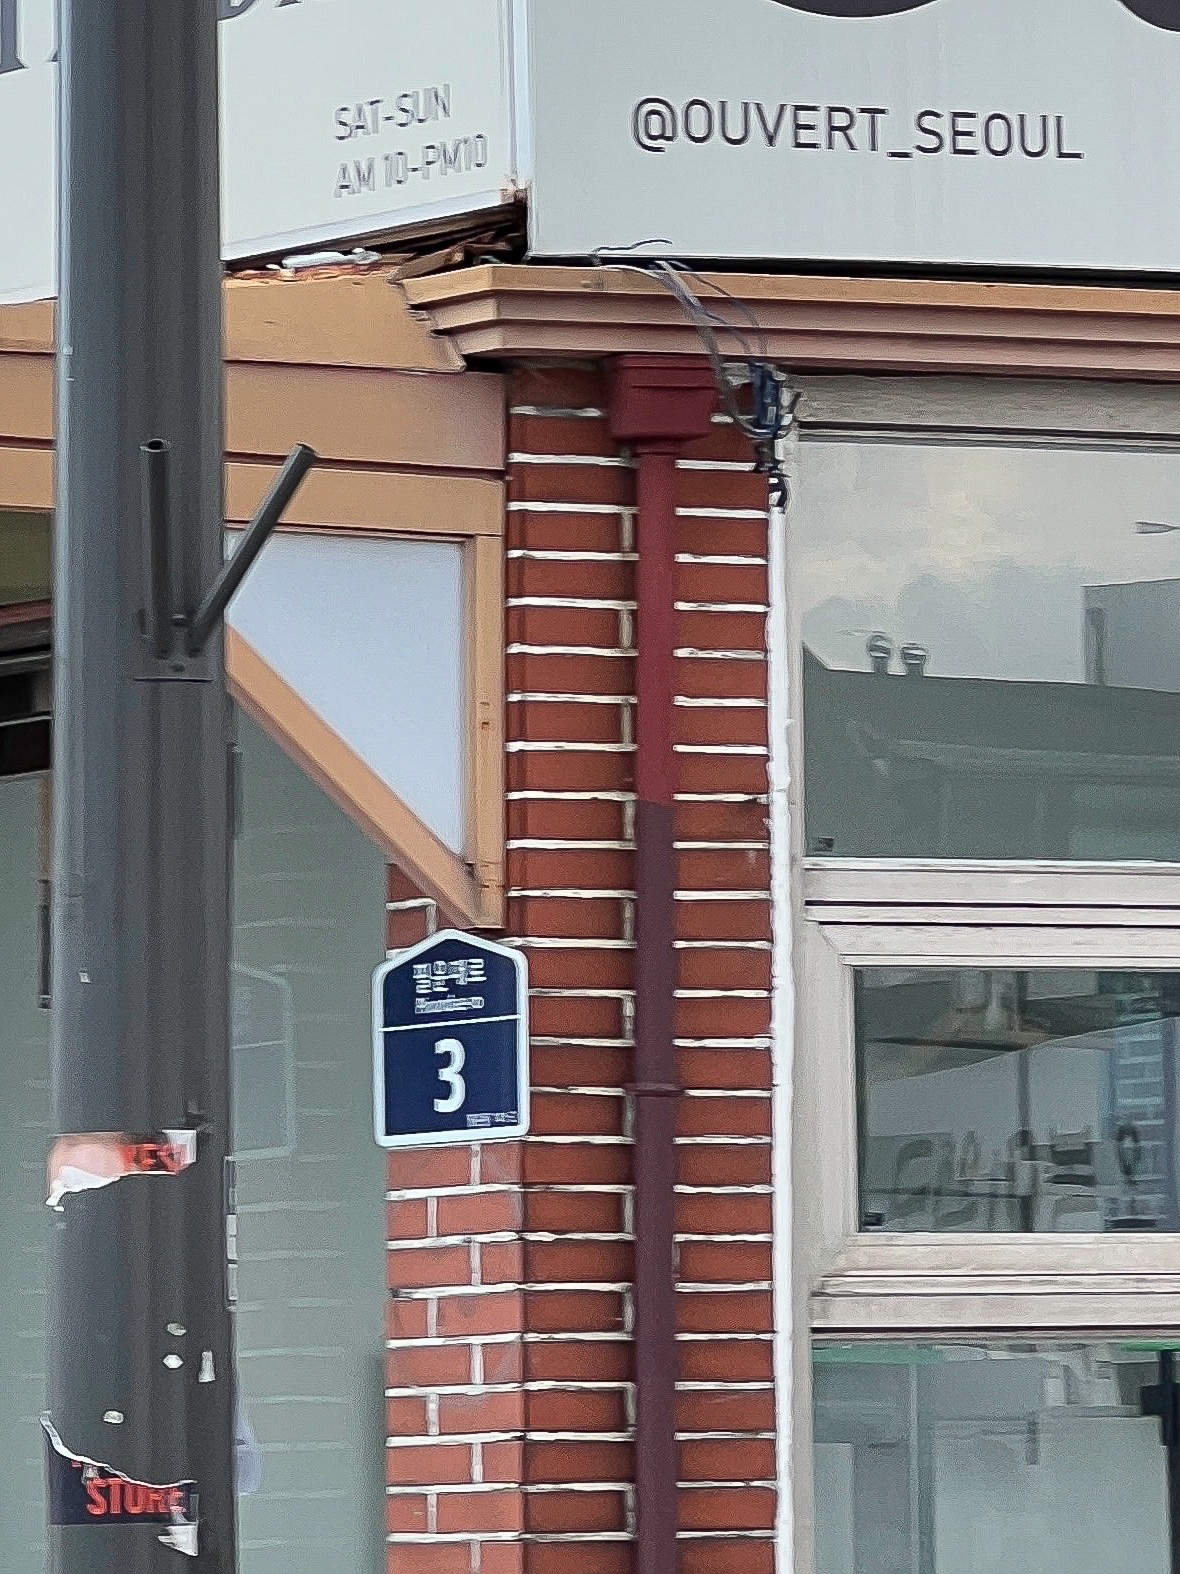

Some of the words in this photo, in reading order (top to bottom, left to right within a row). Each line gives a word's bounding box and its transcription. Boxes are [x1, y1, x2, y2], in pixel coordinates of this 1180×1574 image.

[334, 84, 450, 140] SAT-SUN
[632, 97, 1085, 160] @OUVERT_SEOUL
[334, 157, 376, 198] AM
[433, 1037, 466, 1113] 3
